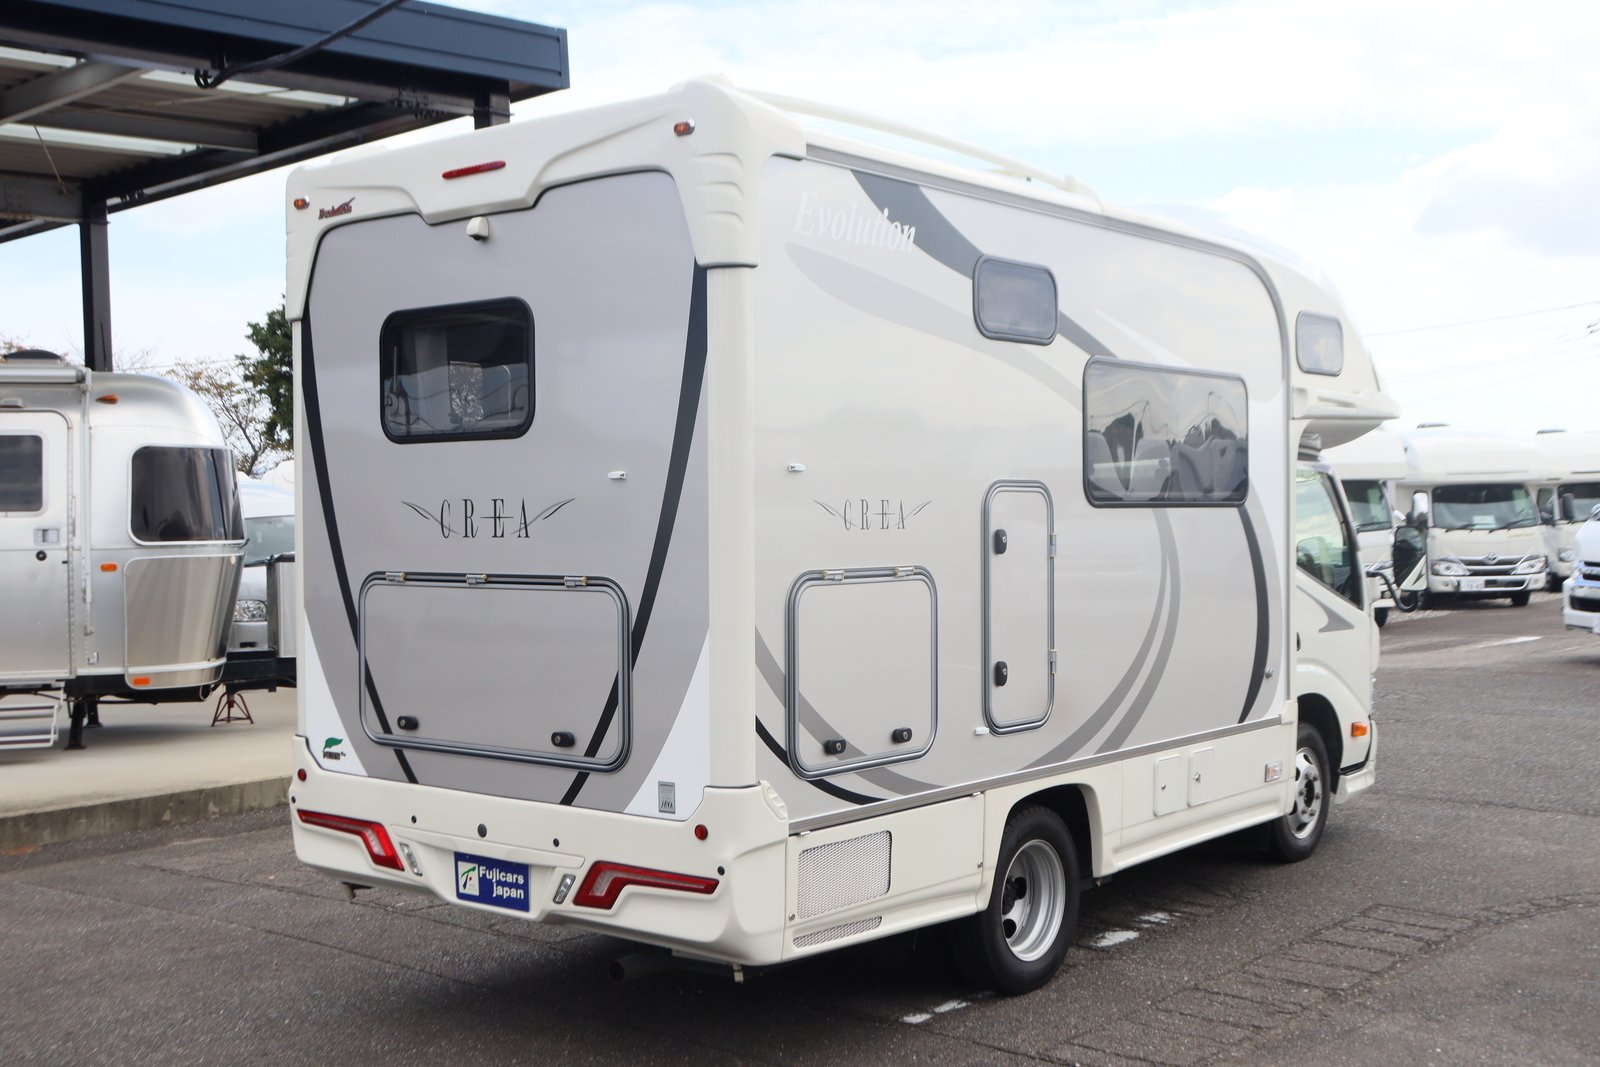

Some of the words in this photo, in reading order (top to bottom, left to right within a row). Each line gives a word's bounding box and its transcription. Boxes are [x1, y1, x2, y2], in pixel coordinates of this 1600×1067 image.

[792, 190, 916, 253] Evolution
[440, 498, 531, 539] CREA
[843, 499, 906, 531] CREA
[479, 866, 524, 885] Fujicars
[492, 882, 524, 899] japan
